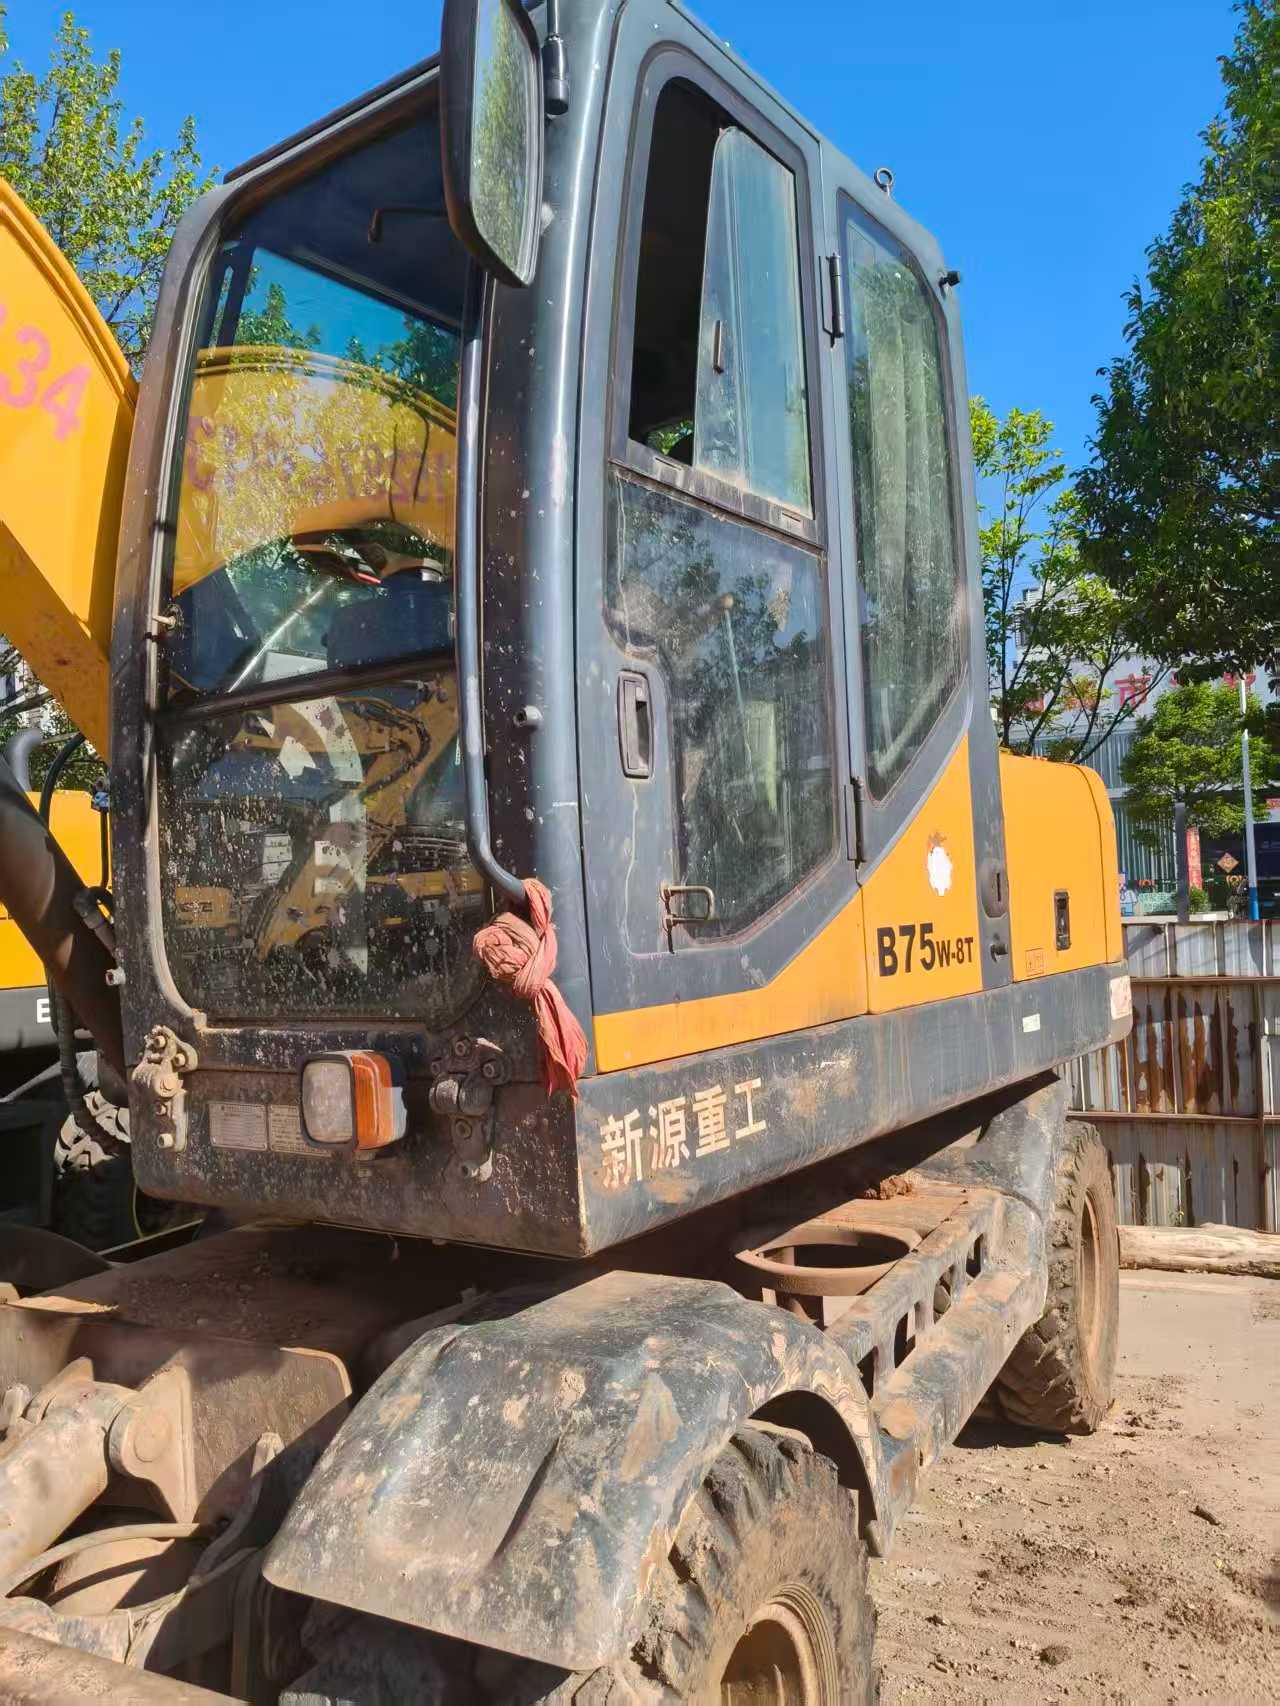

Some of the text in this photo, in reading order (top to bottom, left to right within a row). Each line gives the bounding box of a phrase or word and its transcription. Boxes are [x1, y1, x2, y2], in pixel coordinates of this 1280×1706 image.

[0, 303, 92, 442] 34
[600, 1077, 767, 1189] 新源重工
